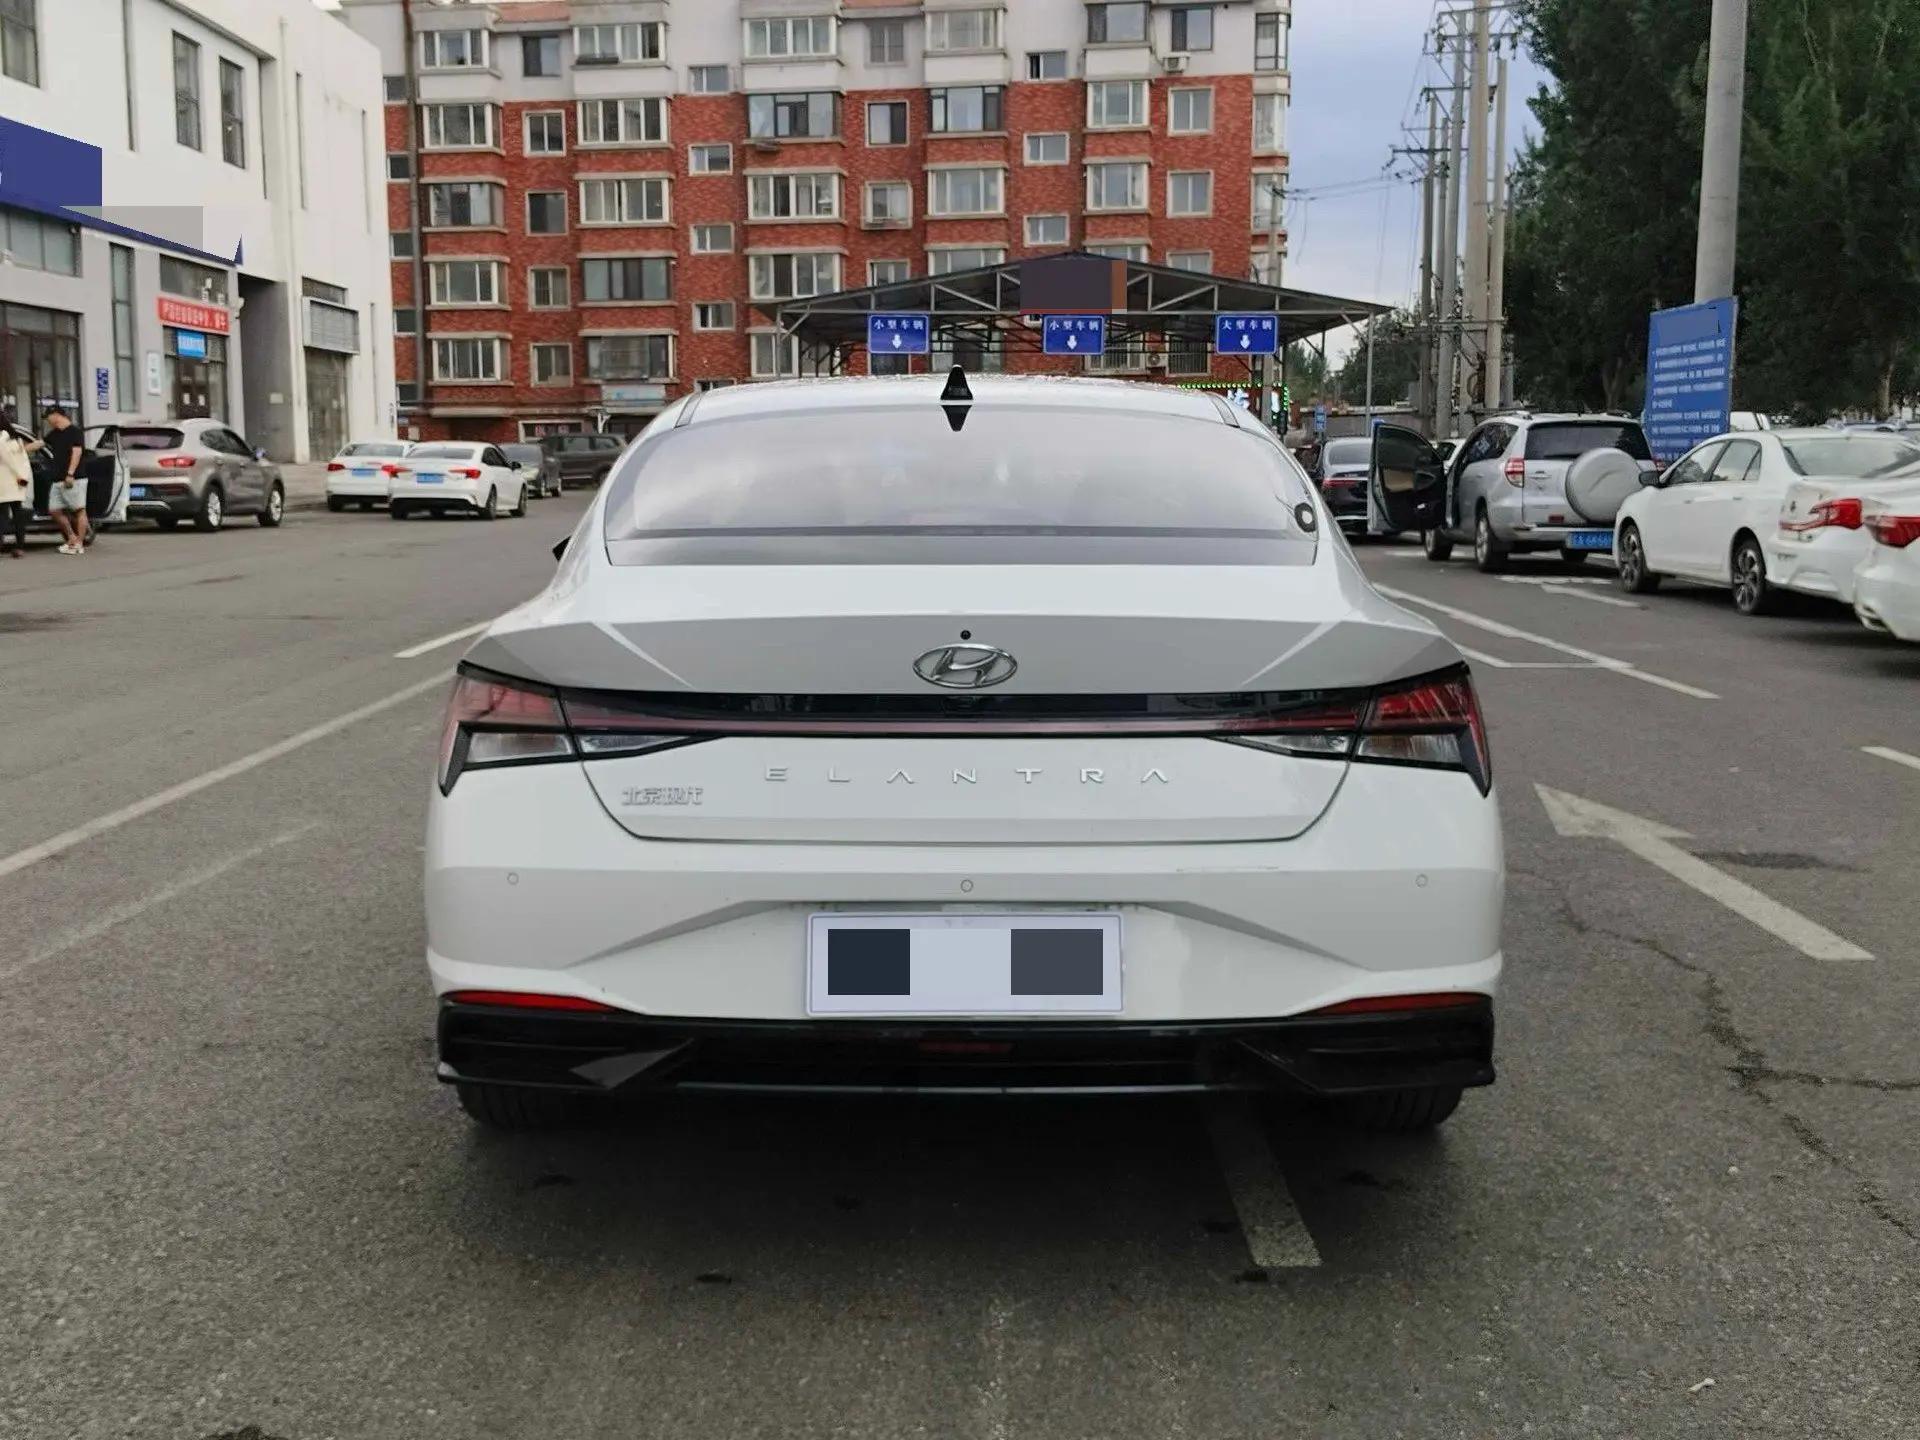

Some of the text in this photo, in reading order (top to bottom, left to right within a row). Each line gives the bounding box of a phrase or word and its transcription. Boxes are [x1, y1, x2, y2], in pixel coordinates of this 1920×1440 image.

[873, 319, 923, 330] 小型车辆
[1049, 320, 1099, 331] 小型车辆
[1221, 319, 1272, 330] 大型车辆
[764, 767, 1170, 784] ELANTRA
[621, 786, 704, 806] 北京现代
